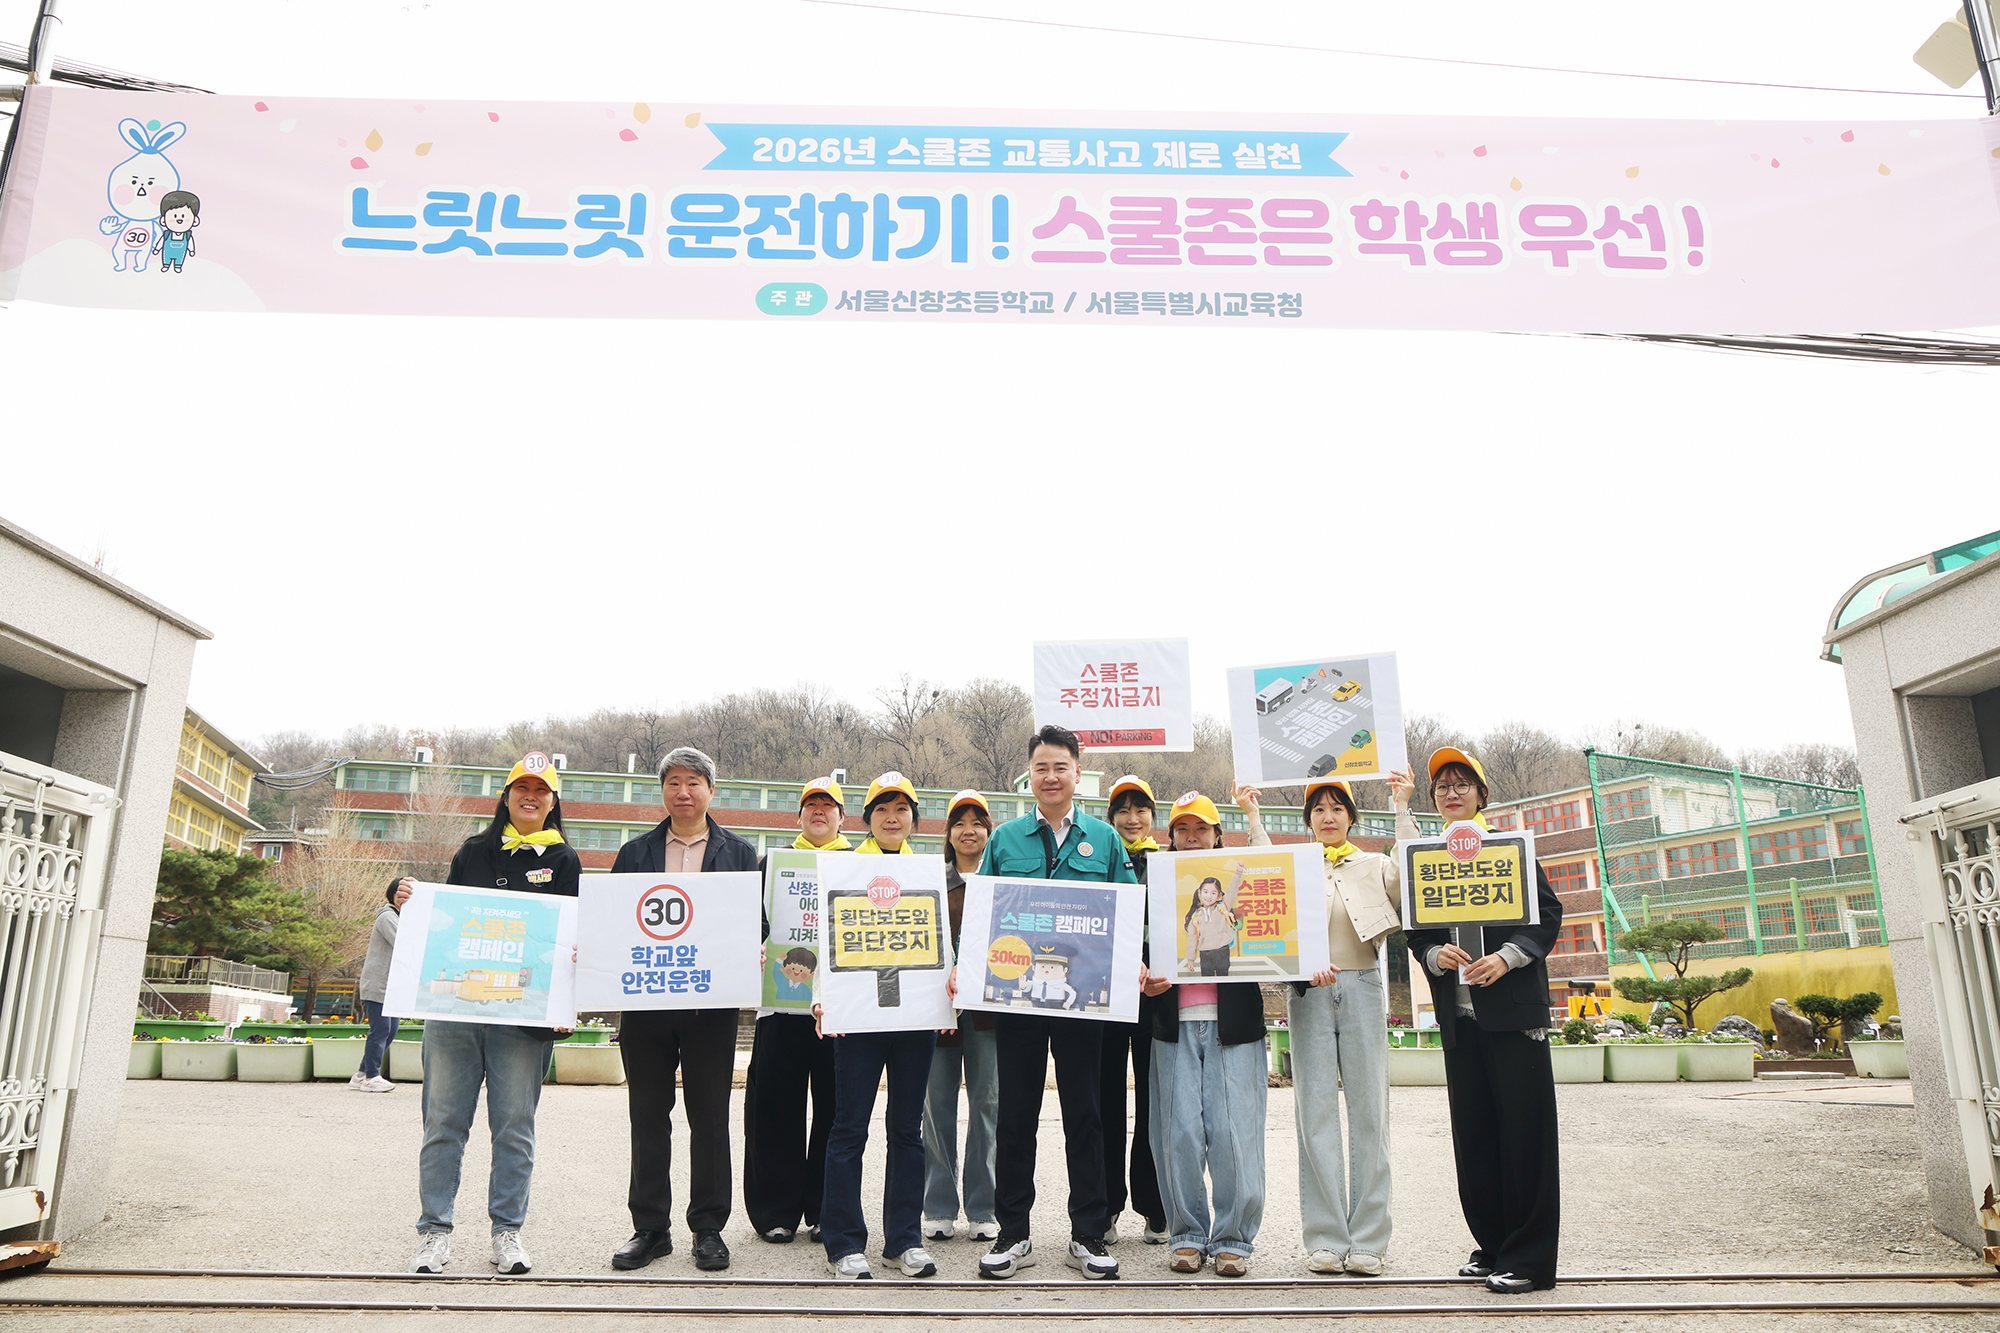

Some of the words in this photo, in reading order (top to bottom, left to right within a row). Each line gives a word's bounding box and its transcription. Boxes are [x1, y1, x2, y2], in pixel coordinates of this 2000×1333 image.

[752, 136, 876, 165] 2026년
[887, 137, 991, 166] 스쿨존
[1003, 139, 1142, 168] 교통사고
[1152, 141, 1222, 168] 제로
[1233, 142, 1302, 169] 실천
[127, 232, 147, 243] 30
[342, 188, 646, 258] 느릿느릿
[1032, 196, 1332, 266] 스쿨존은
[1350, 199, 1502, 265] 학생
[835, 290, 1054, 314] 서울신창초등학교
[1064, 292, 1077, 312] /
[1086, 292, 1302, 317] 서울특별시교육청
[1080, 662, 1139, 684] 스쿨존
[1060, 686, 1160, 708] 주정차금지
[1281, 700, 1332, 740] 스쿨존
[1294, 707, 1357, 748] 캠페인
[1091, 730, 1113, 744] NO!
[1116, 732, 1153, 742] PARKING
[529, 757, 544, 769] 30
[816, 779, 829, 788] 30
[884, 775, 898, 784] 30
[1181, 793, 1195, 804] 30
[1451, 838, 1477, 851] STOP
[1420, 859, 1513, 882] 횡단보도앞
[871, 887, 897, 899] STOP
[1237, 878, 1286, 896] 스쿨존
[1422, 882, 1514, 908] 일단정지
[644, 898, 685, 926] 30
[841, 909, 929, 926] 횡단보도앞
[1238, 898, 1288, 917] 주정차
[461, 917, 527, 941] 스쿨존
[1000, 912, 1053, 933] 스쿨존
[1055, 915, 1108, 936] 캠페인
[1246, 919, 1280, 937] 금지
[458, 938, 524, 963] 캠페인
[843, 930, 930, 952] 일단정지
[631, 945, 698, 968] 학교앞
[990, 950, 1031, 966] 30km
[621, 970, 711, 995] 안전운행
